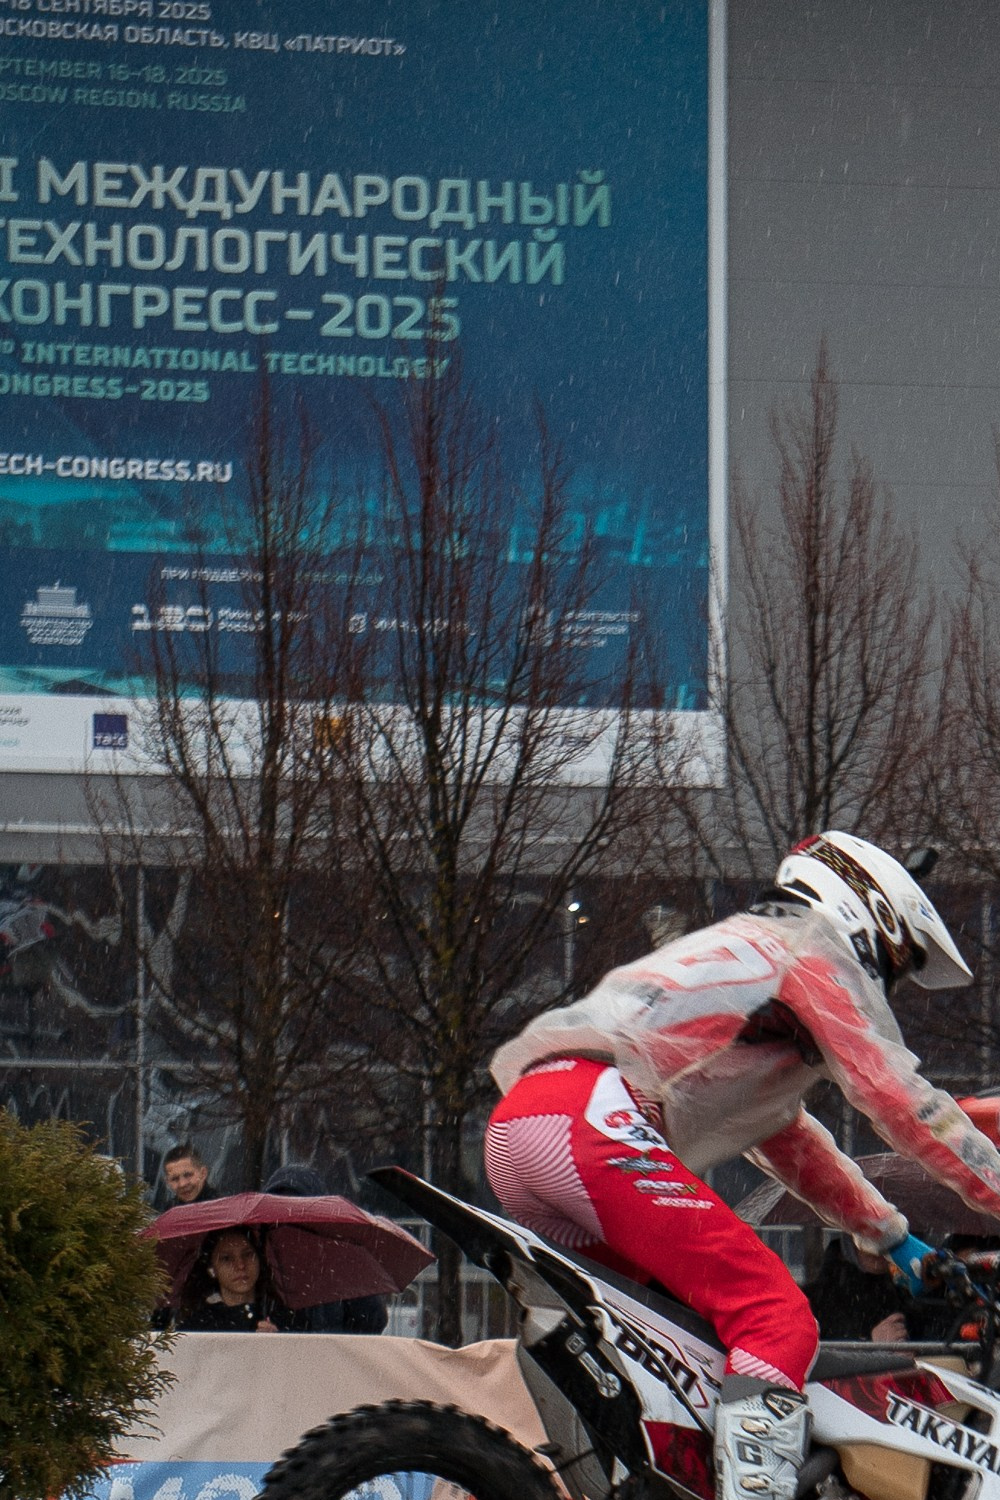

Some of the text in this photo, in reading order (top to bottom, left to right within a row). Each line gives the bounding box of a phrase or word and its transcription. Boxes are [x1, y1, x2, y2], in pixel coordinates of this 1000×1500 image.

[158, 1, 212, 21] 2025
[0, 19, 406, 57] СКОВСКАЯ ОБЛАСТЬ, КВЦ «ПАТРИОТ»
[175, 66, 229, 86] 2025
[0, 82, 68, 104] SCOW
[167, 93, 246, 113] RUSSIA
[38, 160, 612, 228] МЕЖДУНАРОДНЫЙ
[0, 217, 565, 286] ЕХНОЛОГИЧЕСКИЙ
[21, 343, 258, 373] INTERNATIONAL
[267, 352, 450, 380] TECHNOLOGY
